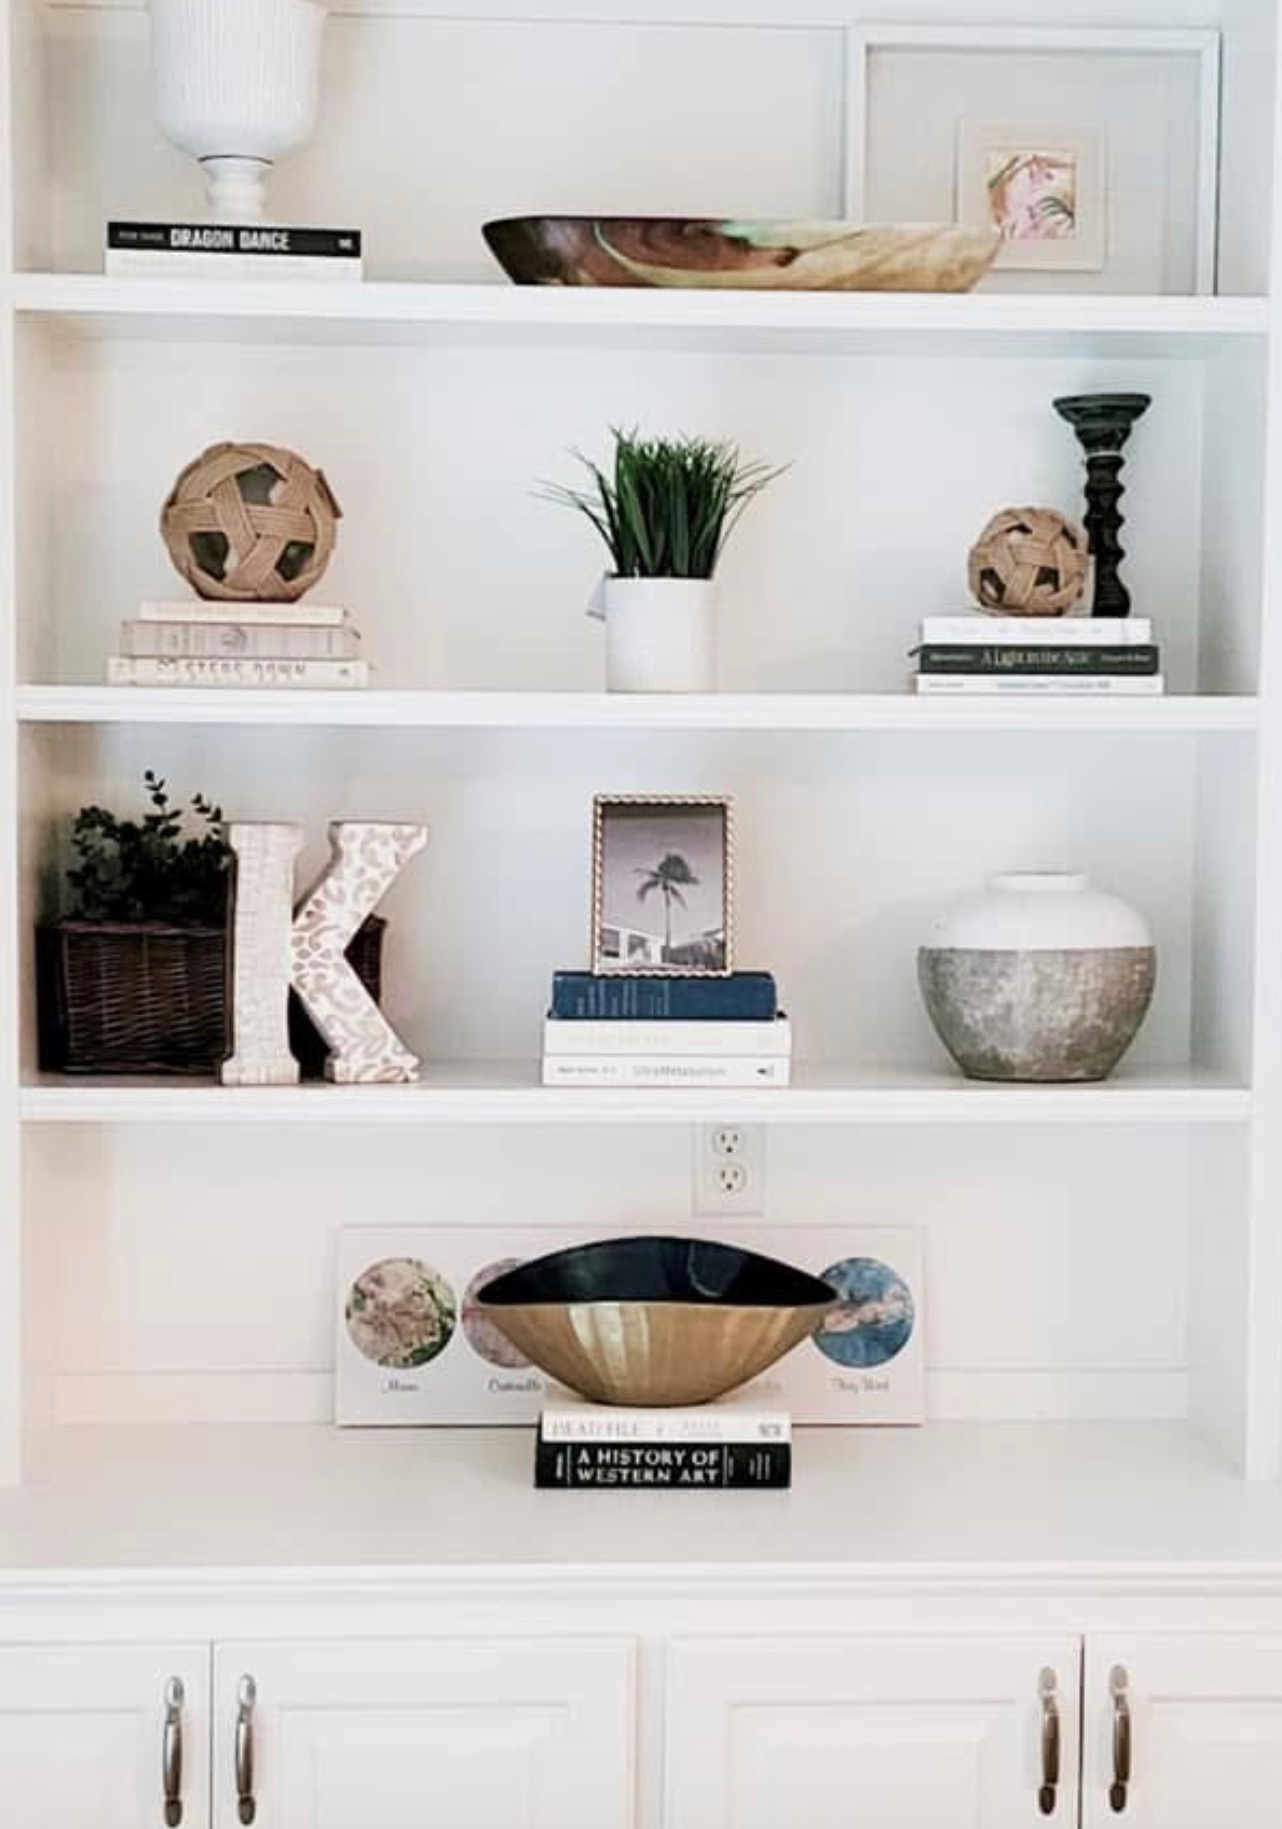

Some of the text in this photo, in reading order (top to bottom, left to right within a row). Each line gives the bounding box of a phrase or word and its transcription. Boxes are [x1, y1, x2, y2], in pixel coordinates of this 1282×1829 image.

[170, 228, 234, 248] DRAGON
[239, 230, 290, 250] DANCE
[577, 1449, 719, 1466] A HISTORY OF
[577, 1467, 719, 1484] WESTERN ART
